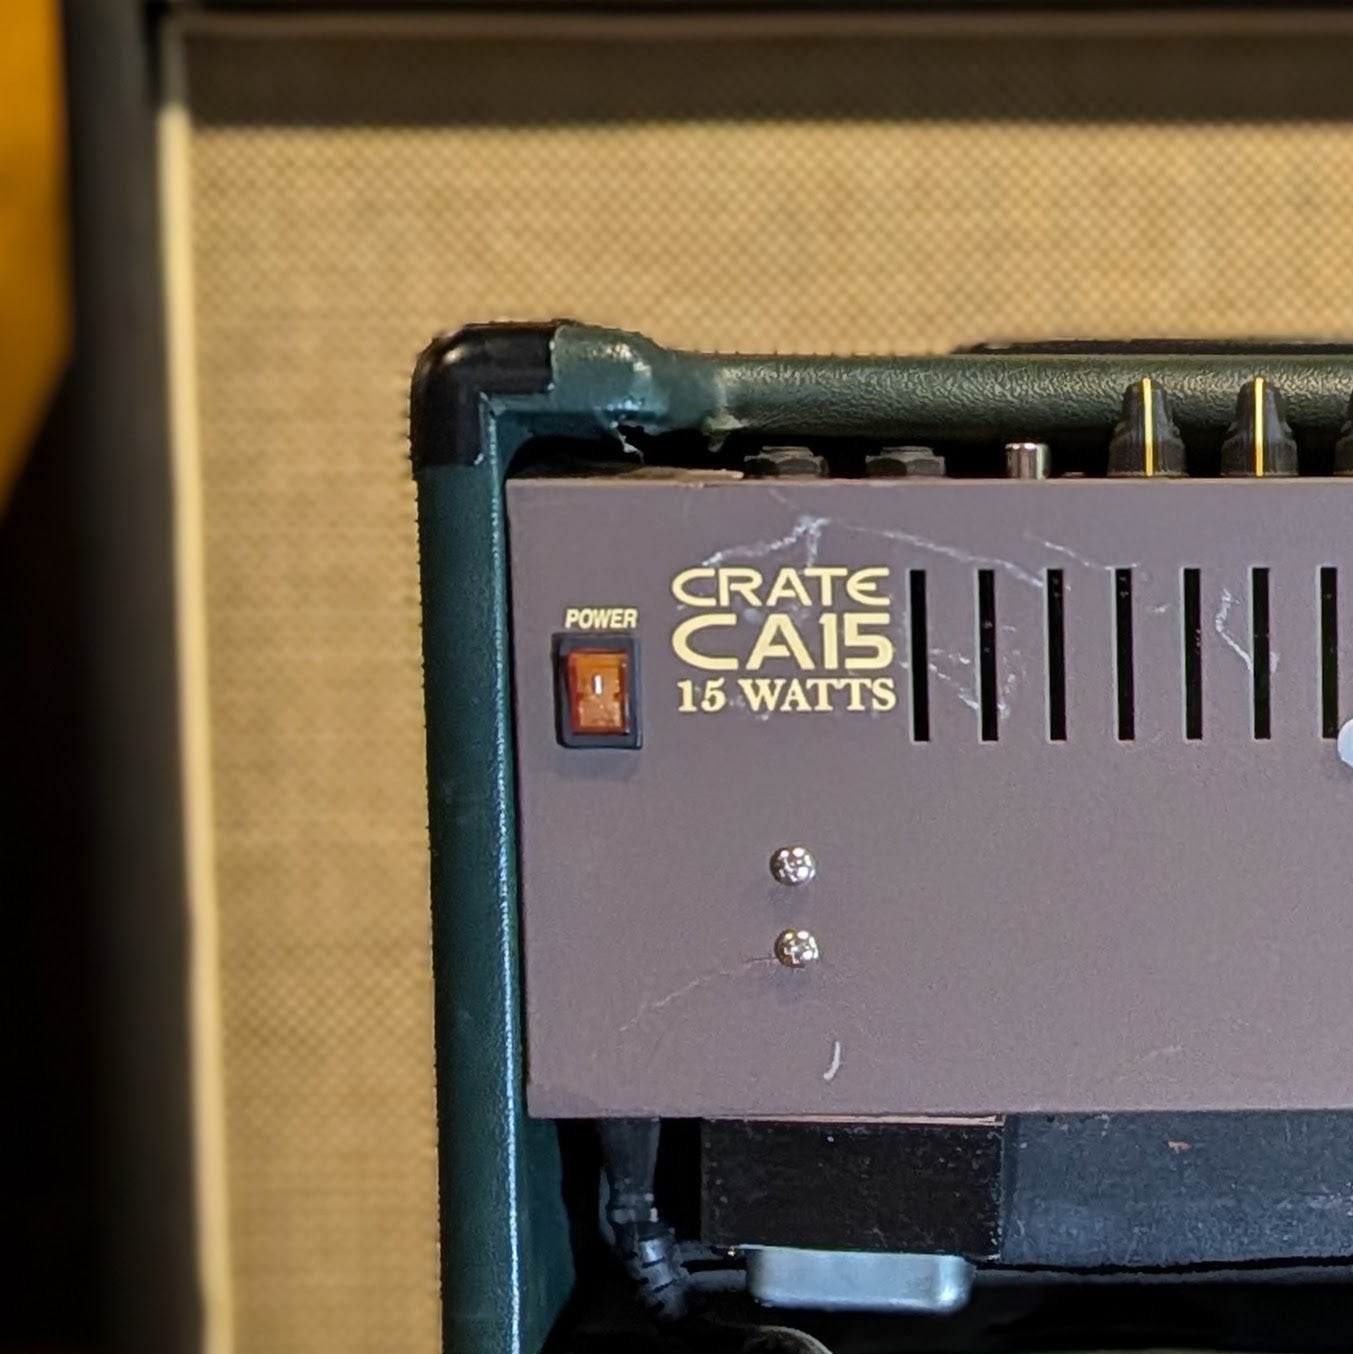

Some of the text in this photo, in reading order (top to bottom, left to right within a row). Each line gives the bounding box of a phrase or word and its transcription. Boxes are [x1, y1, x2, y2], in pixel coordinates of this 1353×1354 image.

[672, 567, 890, 607] CRATE
[565, 609, 638, 629] POWER
[671, 613, 894, 670] CA15
[677, 677, 897, 712] 15 WATTS
